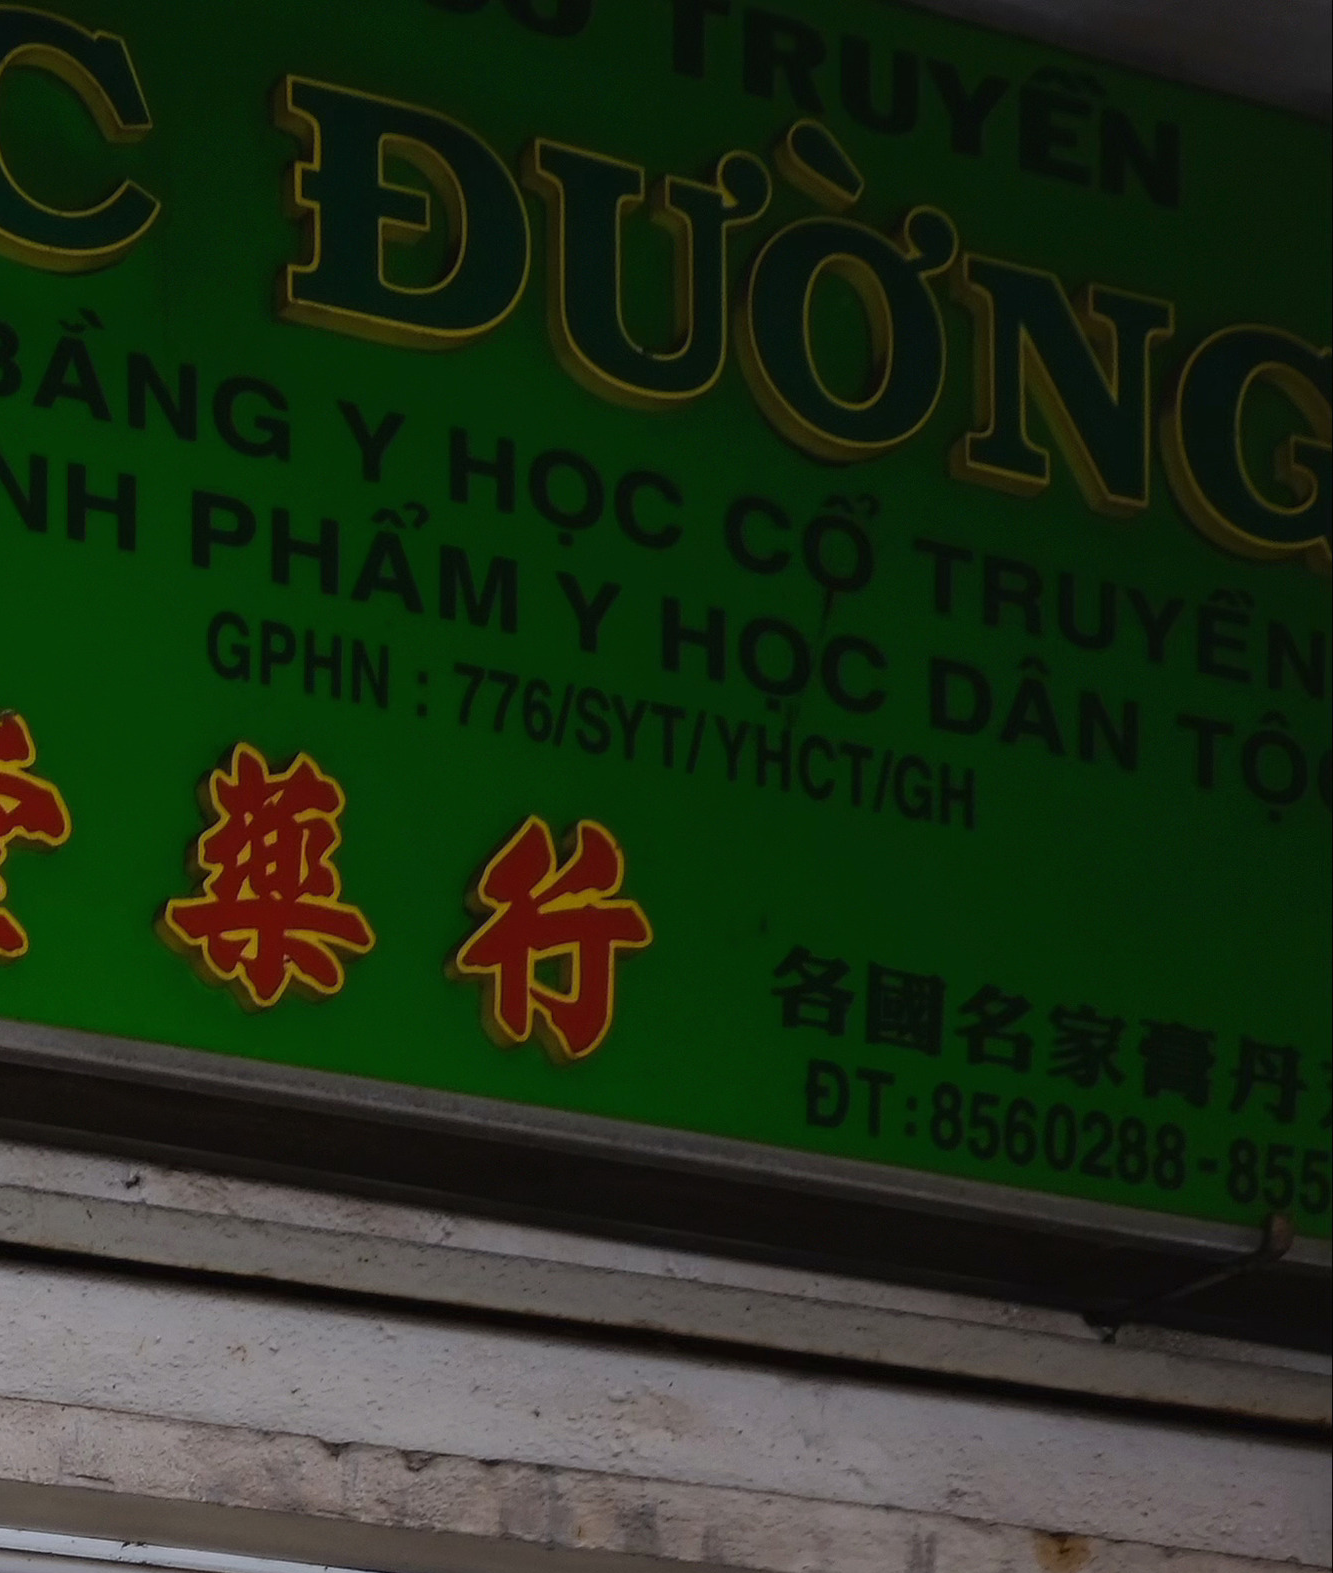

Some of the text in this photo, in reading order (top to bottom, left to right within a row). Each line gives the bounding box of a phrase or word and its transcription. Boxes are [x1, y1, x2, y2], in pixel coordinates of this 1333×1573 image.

[272, 72, 1333, 572] ĐƯỜNG
[189, 486, 520, 635] PHẨM
[556, 571, 623, 654] Y
[660, 603, 888, 724] HỌC
[929, 653, 1139, 774] DÂN
[1176, 709, 1333, 823] TỘ
[337, 401, 406, 483] Y
[448, 426, 684, 548] HỌC
[724, 493, 879, 593] CỔ
[913, 536, 1325, 701] TRUYỀN
[205, 610, 979, 830] GPHN 776/SYT/YHCT/GH
[770, 944, 1333, 1131] 各國名家膏丹
